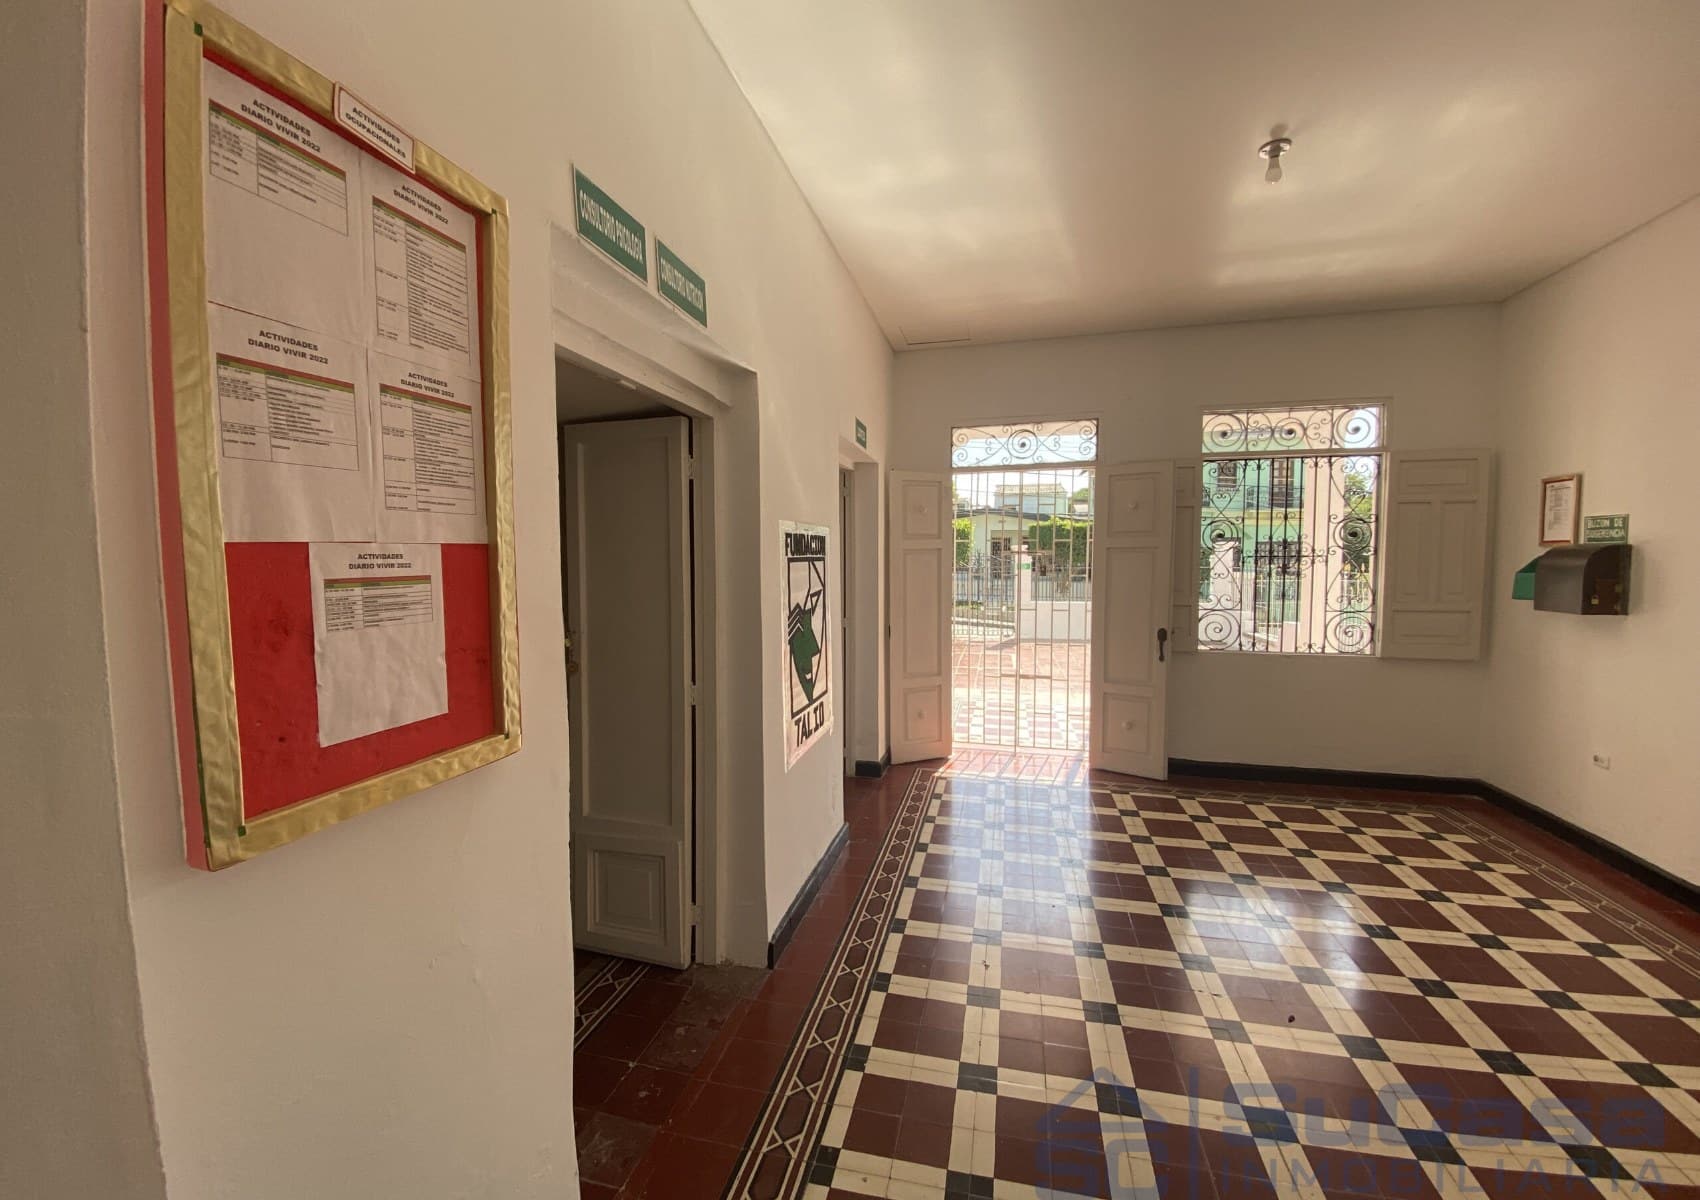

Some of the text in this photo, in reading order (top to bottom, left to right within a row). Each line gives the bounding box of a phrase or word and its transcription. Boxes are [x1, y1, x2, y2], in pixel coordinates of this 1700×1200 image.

[241, 104, 321, 153] DIARIO VIVIR 2022
[252, 99, 311, 137] ACTIVIDADES
[352, 106, 400, 144] ACTIVIDADES
[345, 112, 407, 159] OCUPACIONALES
[393, 189, 449, 225] DIARIO VIVIR 2022
[402, 184, 442, 212] ACTIVIDADES
[579, 188, 616, 242] CONSULTORIO
[248, 338, 329, 365] DIARIO VIVIR 2022
[259, 330, 318, 351] ACTIVIDADES
[400, 379, 455, 398] DIARIO VIVIR 2022
[408, 372, 448, 388] ACTIVIDADES
[1614, 517, 1623, 527] DE
